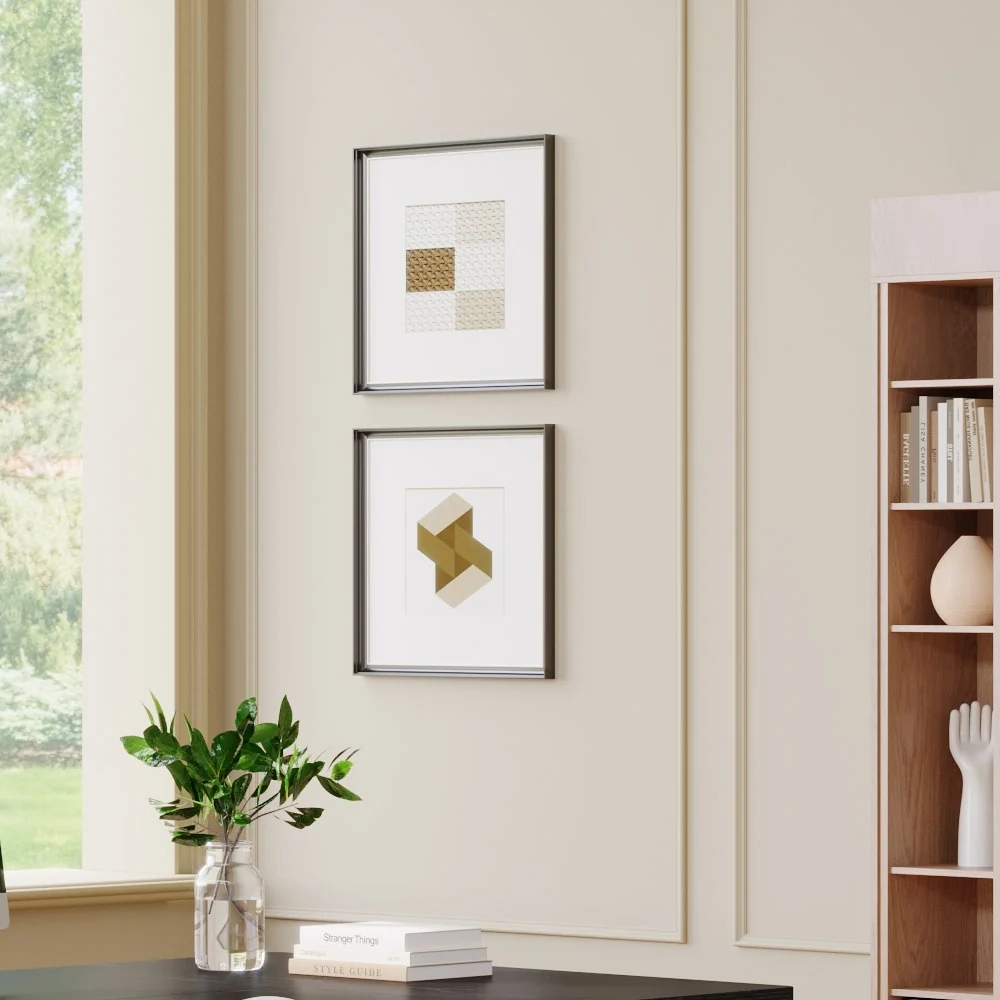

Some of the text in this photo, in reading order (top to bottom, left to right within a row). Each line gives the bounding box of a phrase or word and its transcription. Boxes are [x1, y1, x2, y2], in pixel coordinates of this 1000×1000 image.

[323, 933, 379, 947] Stranger Things
[313, 964, 382, 977] STYLE GUIDE
